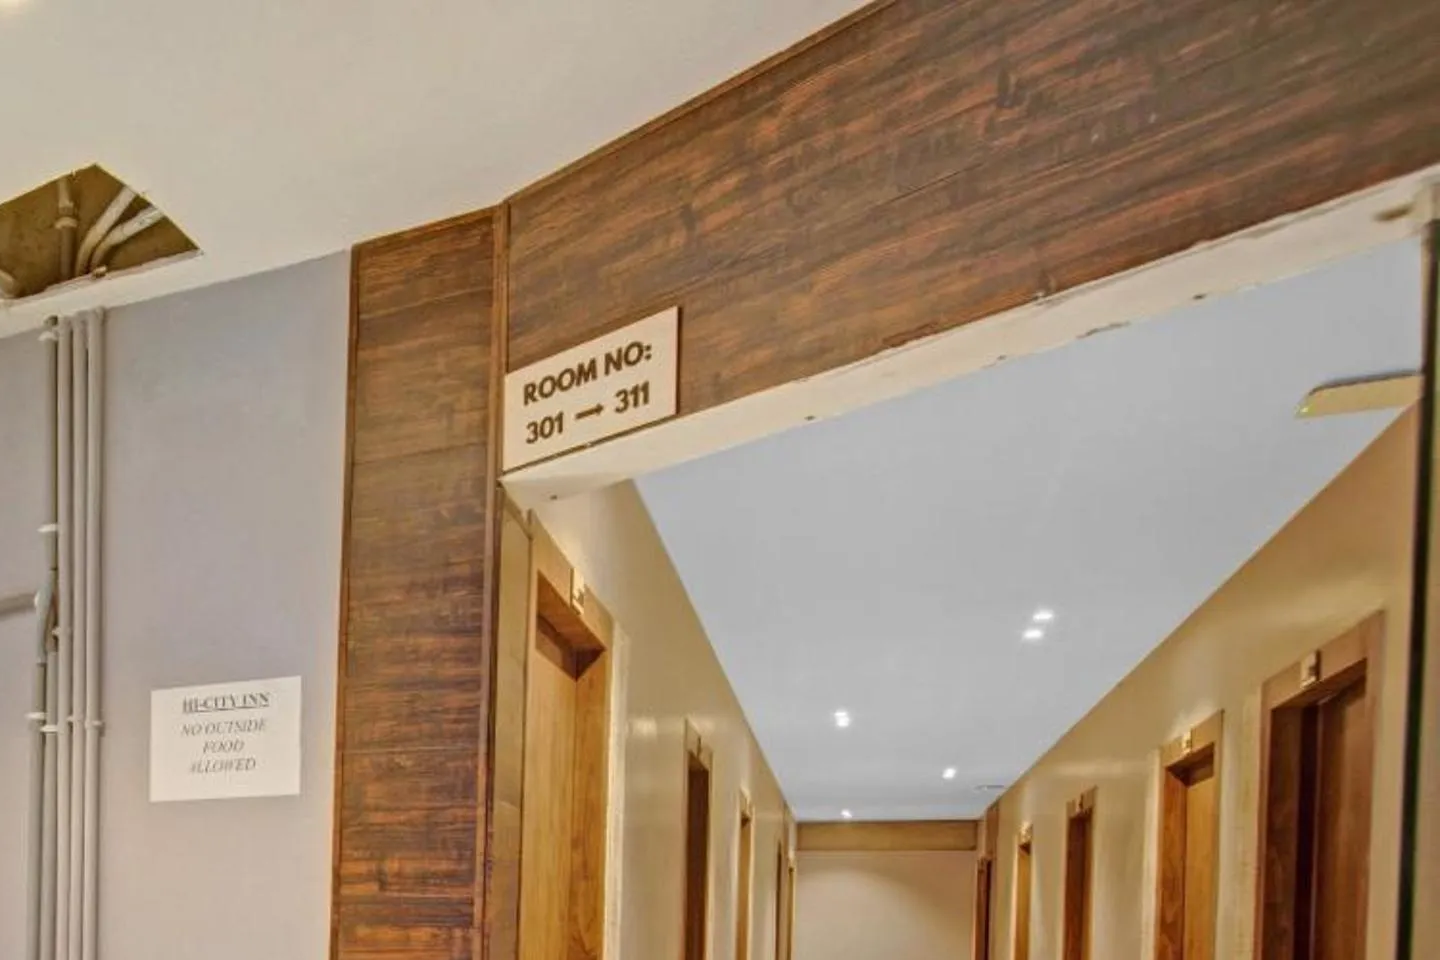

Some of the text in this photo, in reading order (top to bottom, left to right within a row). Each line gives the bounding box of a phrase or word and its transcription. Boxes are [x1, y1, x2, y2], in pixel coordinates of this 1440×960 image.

[523, 341, 652, 406] ROOM NO:
[526, 381, 650, 444] 301 311
[242, 692, 270, 708] INN
[181, 718, 267, 737] NO OUTSIDE
[203, 739, 245, 754] FOOD
[191, 757, 257, 773] ALLOWED
